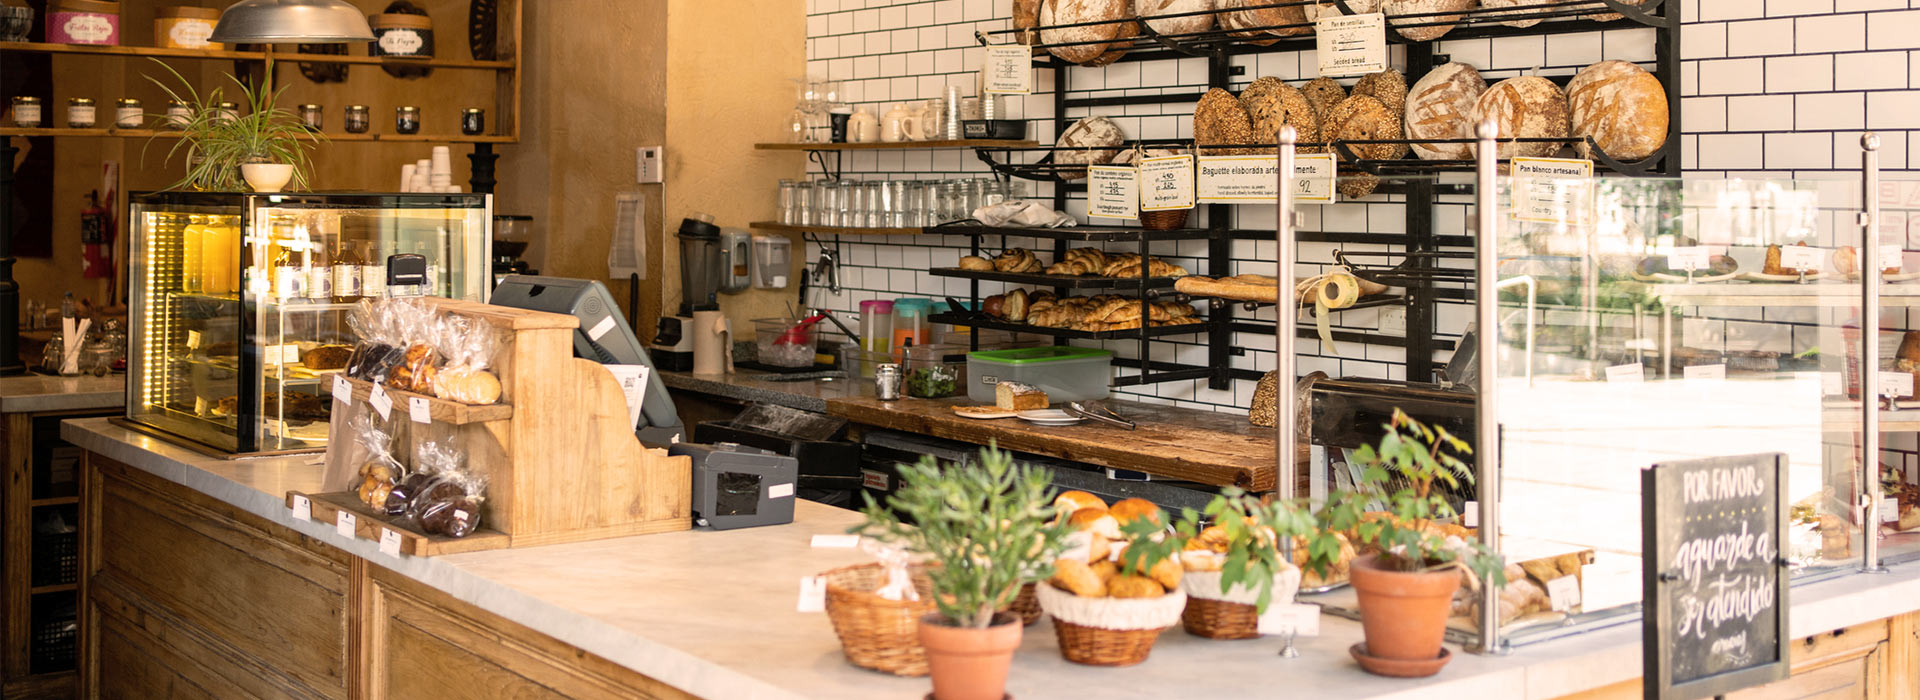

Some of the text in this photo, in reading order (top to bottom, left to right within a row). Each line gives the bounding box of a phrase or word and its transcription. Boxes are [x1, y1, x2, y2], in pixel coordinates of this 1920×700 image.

[1202, 167, 1230, 177] Baguette
[1231, 166, 1263, 175] elaborada
[1532, 165, 1552, 174] blanco
[1553, 167, 1581, 176] artesanal
[1299, 180, 1311, 193] 92
[1683, 466, 1764, 504] POR FAVOR
[1676, 519, 1777, 593] aguarde a
[1706, 573, 1774, 628] atendido
